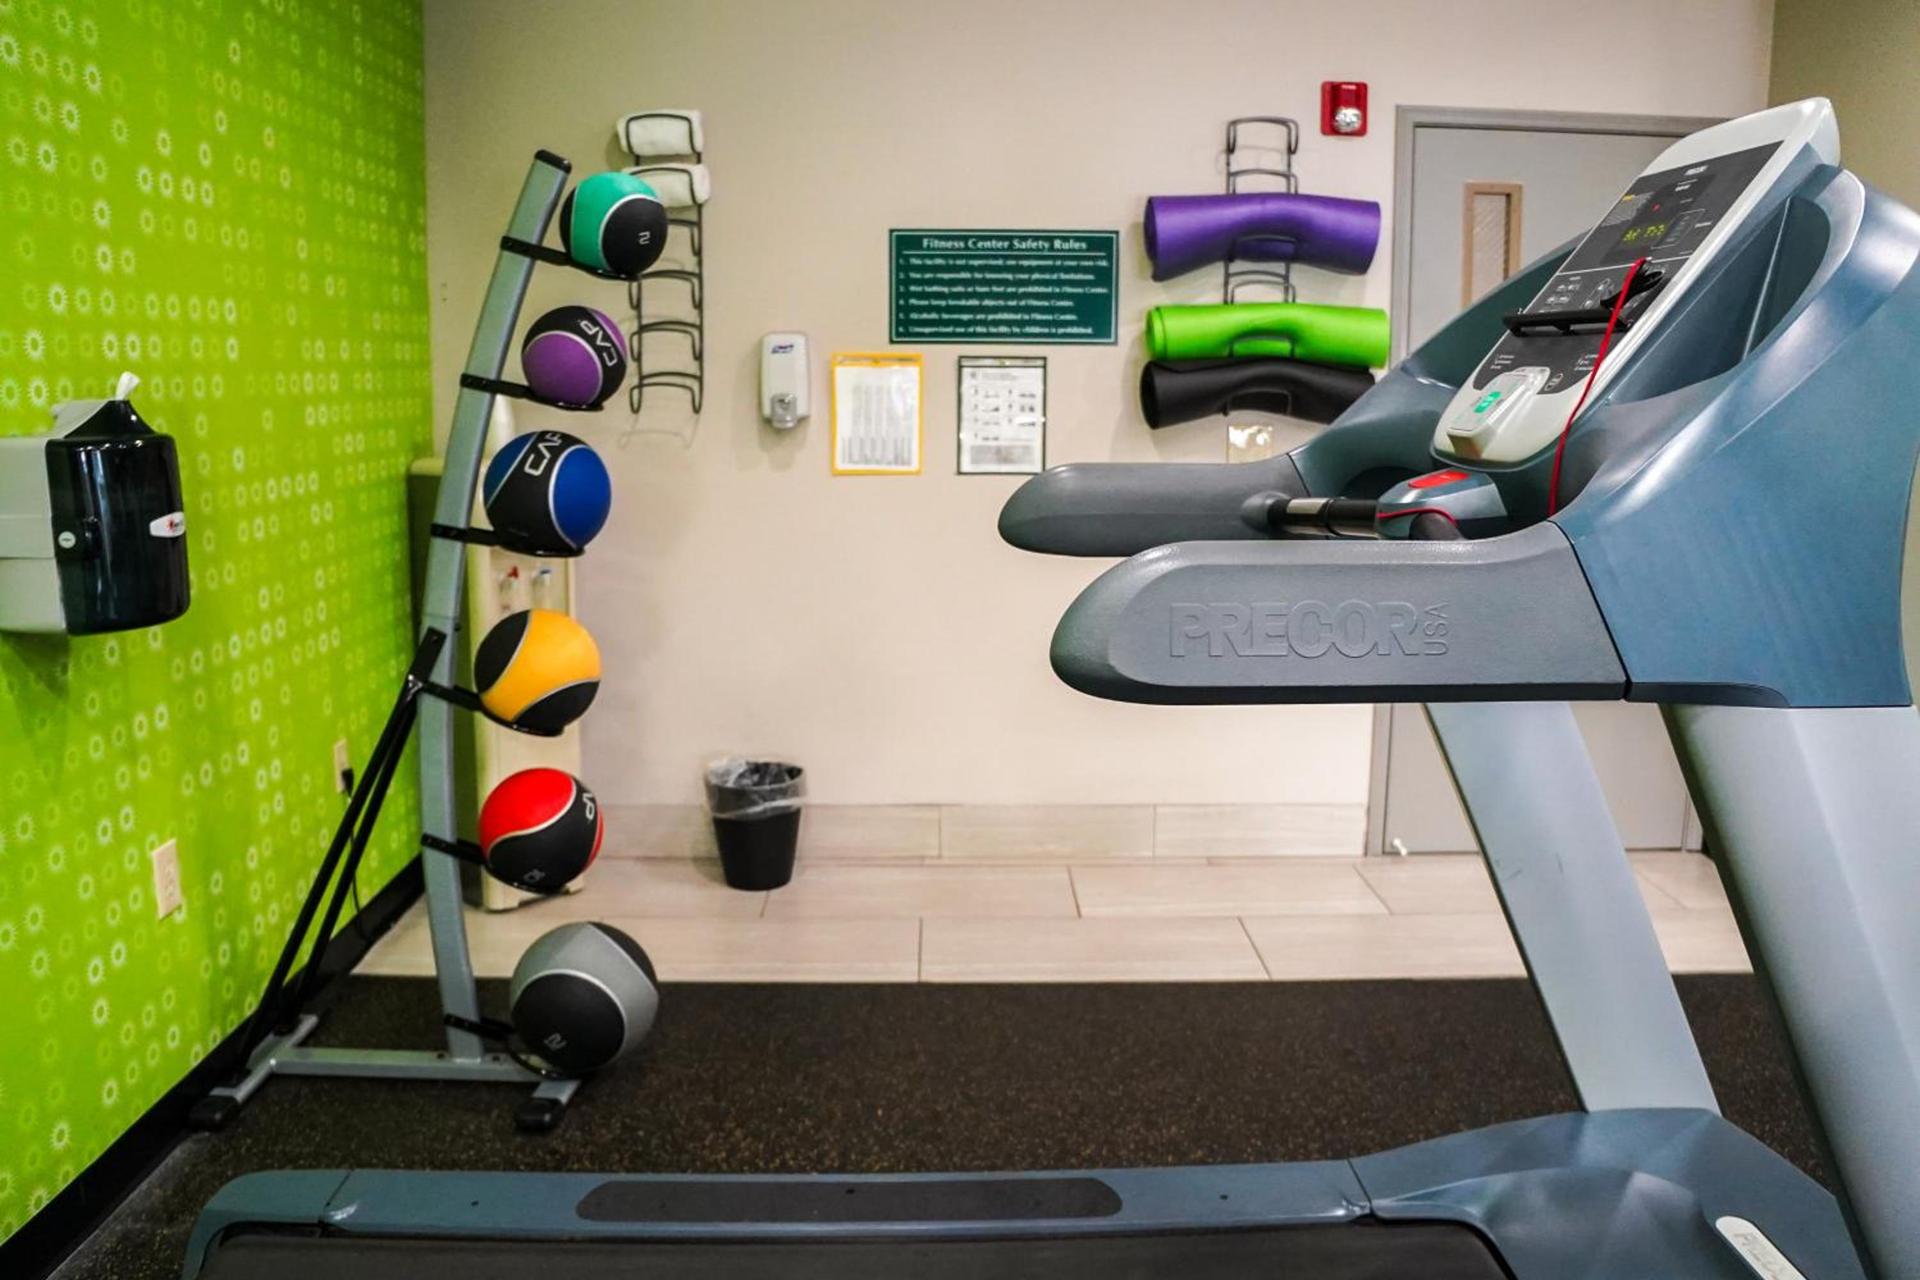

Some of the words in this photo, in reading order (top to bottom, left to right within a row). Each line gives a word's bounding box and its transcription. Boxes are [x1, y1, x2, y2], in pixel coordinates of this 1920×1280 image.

[922, 238, 965, 249] Fitness
[967, 238, 1009, 249] Center
[1012, 239, 1050, 252] Safety
[1053, 239, 1087, 250] Rules
[579, 319, 618, 367] CAP
[1169, 600, 1418, 658] PRECOR
[1422, 602, 1449, 656] USA
